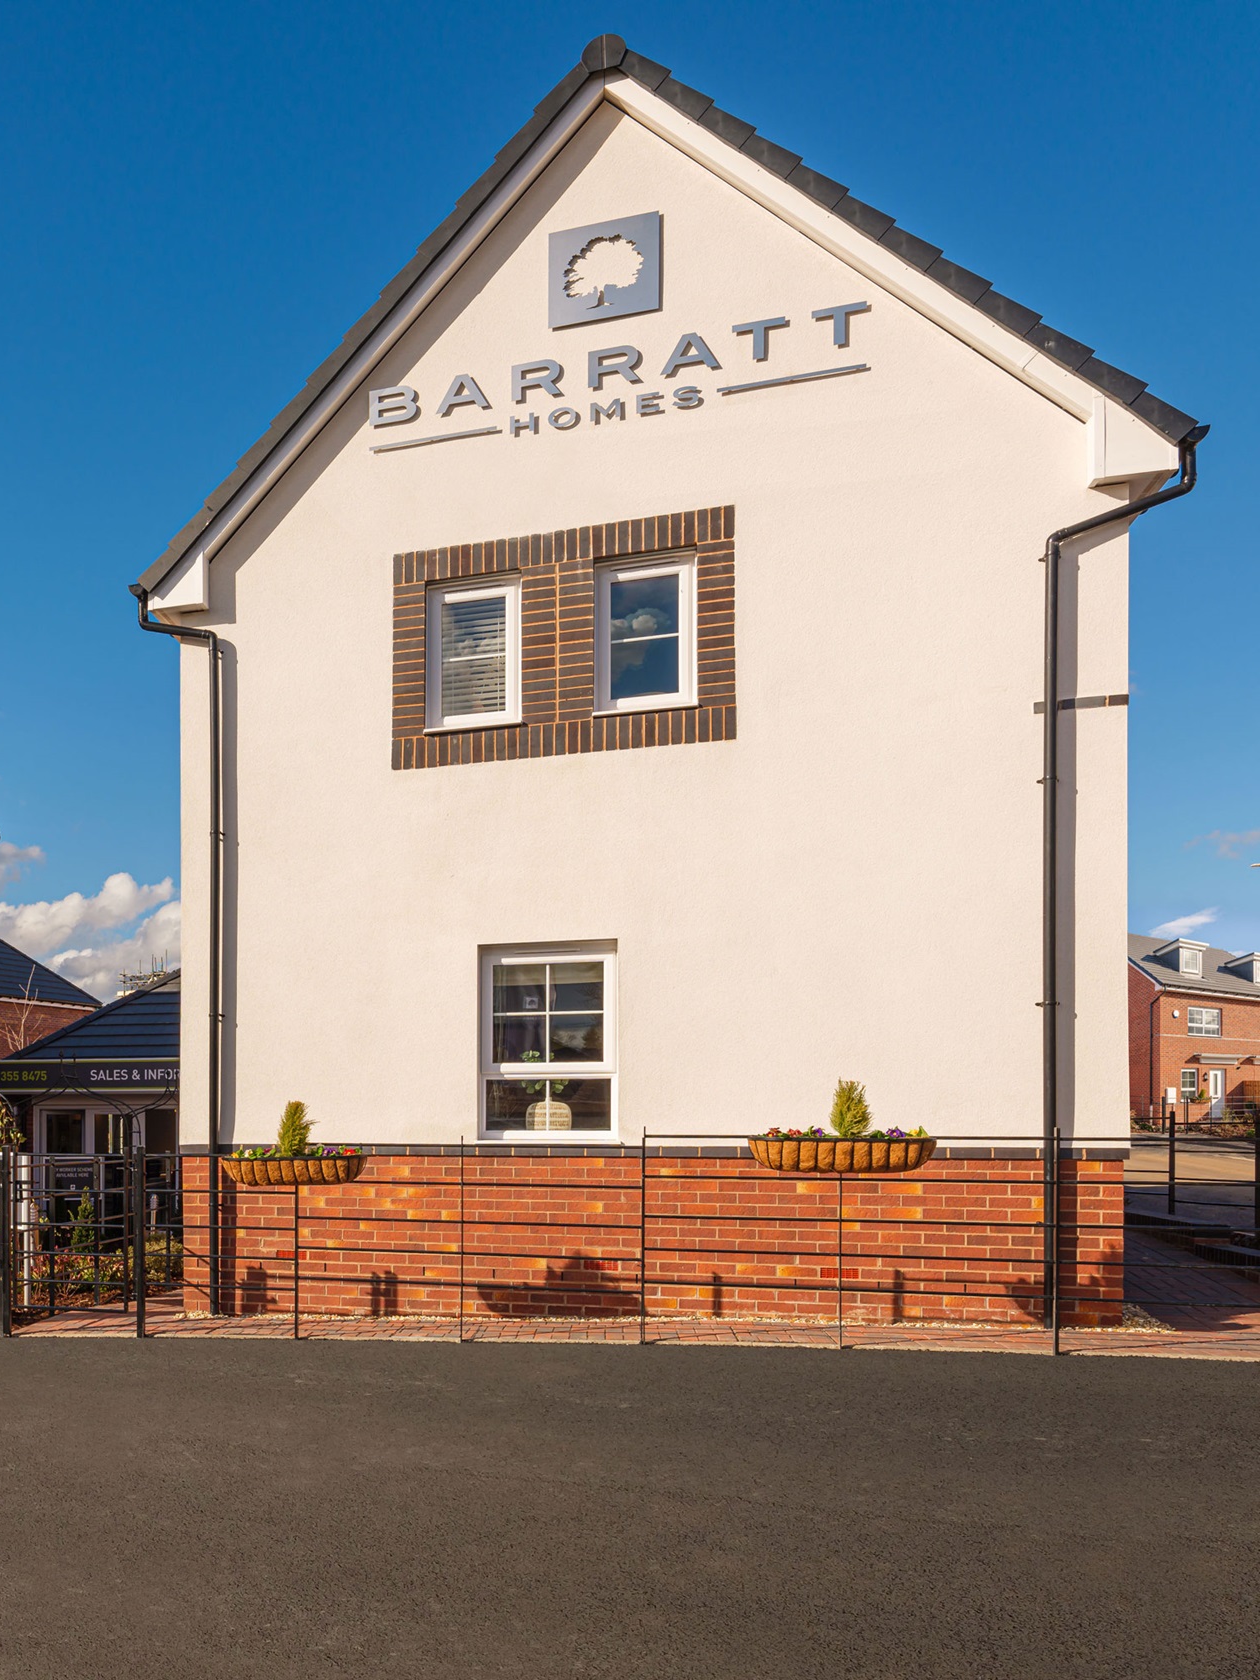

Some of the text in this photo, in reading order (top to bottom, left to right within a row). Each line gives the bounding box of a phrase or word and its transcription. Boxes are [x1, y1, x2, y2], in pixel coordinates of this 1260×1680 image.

[368, 300, 871, 428] BARRATT
[509, 385, 705, 437] HOMES
[0, 1071, 20, 1081] 355
[21, 1070, 47, 1081] 8475
[90, 1069, 129, 1081] SALES
[131, 1069, 141, 1080] &
